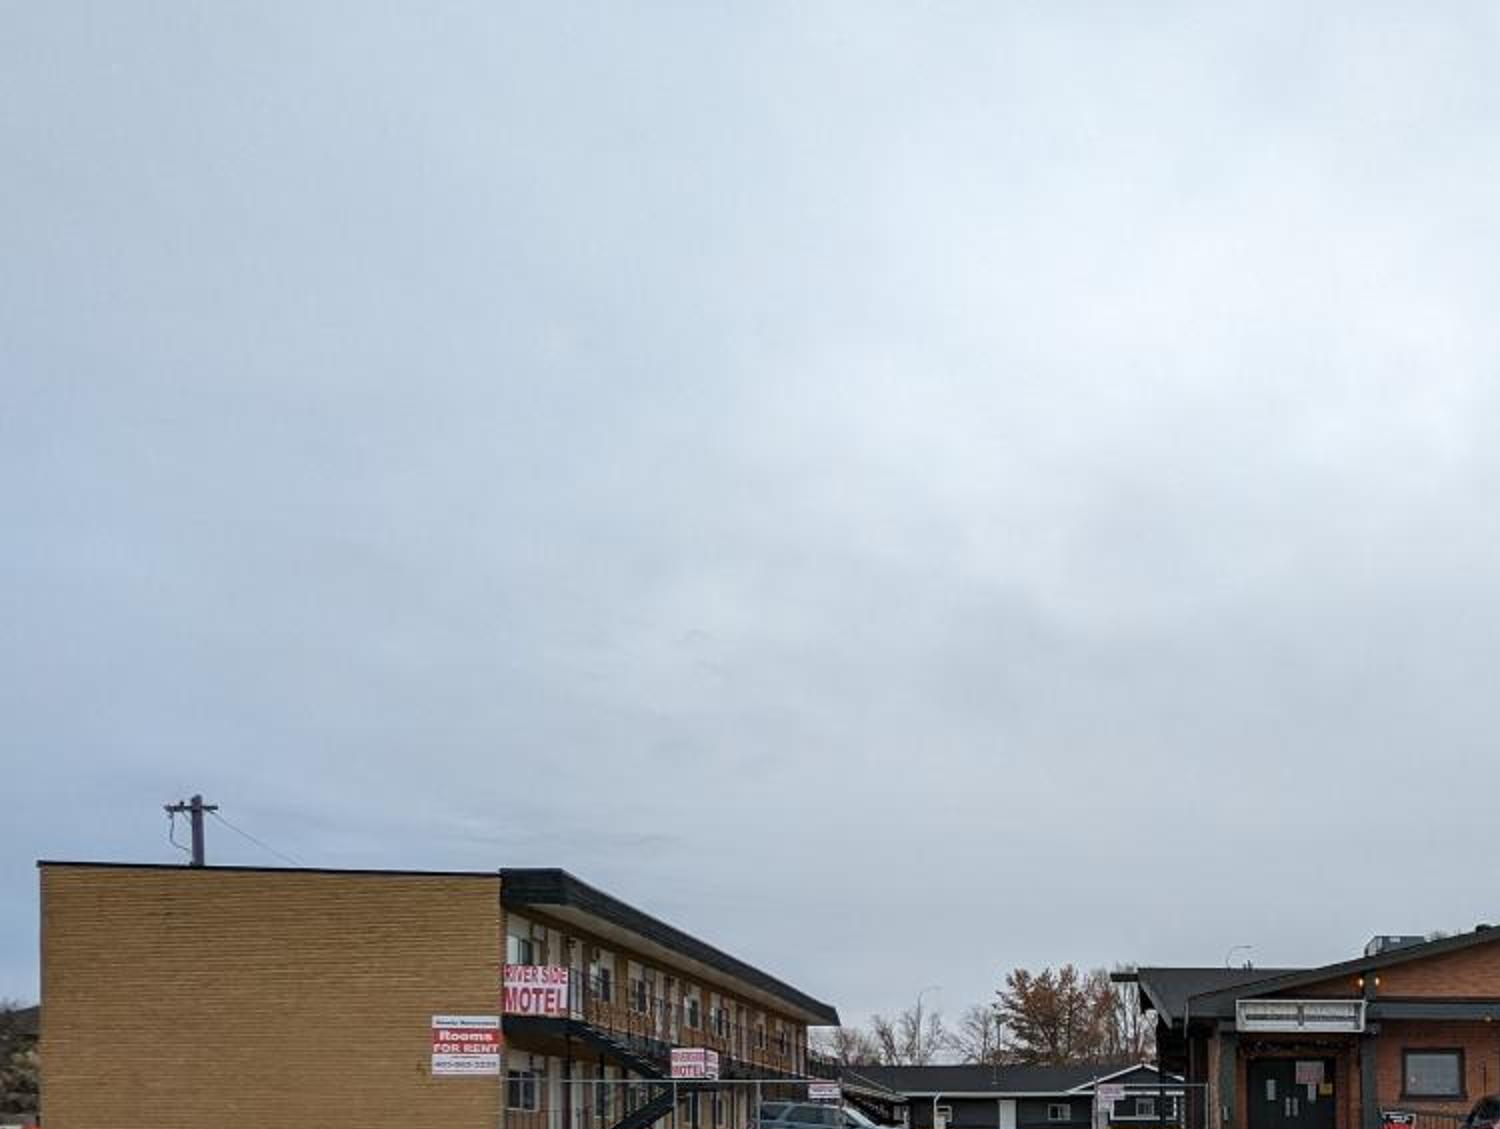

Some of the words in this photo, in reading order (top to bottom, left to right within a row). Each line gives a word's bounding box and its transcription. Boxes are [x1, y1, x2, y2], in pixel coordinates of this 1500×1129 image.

[504, 966, 538, 983] RIVER
[542, 967, 568, 985] SIDE
[503, 987, 567, 1013] MOTEL
[439, 1031, 493, 1042] Rooms
[433, 1043, 461, 1053] FOR
[463, 1043, 499, 1053] RENT
[672, 1064, 705, 1077] MOTEL
